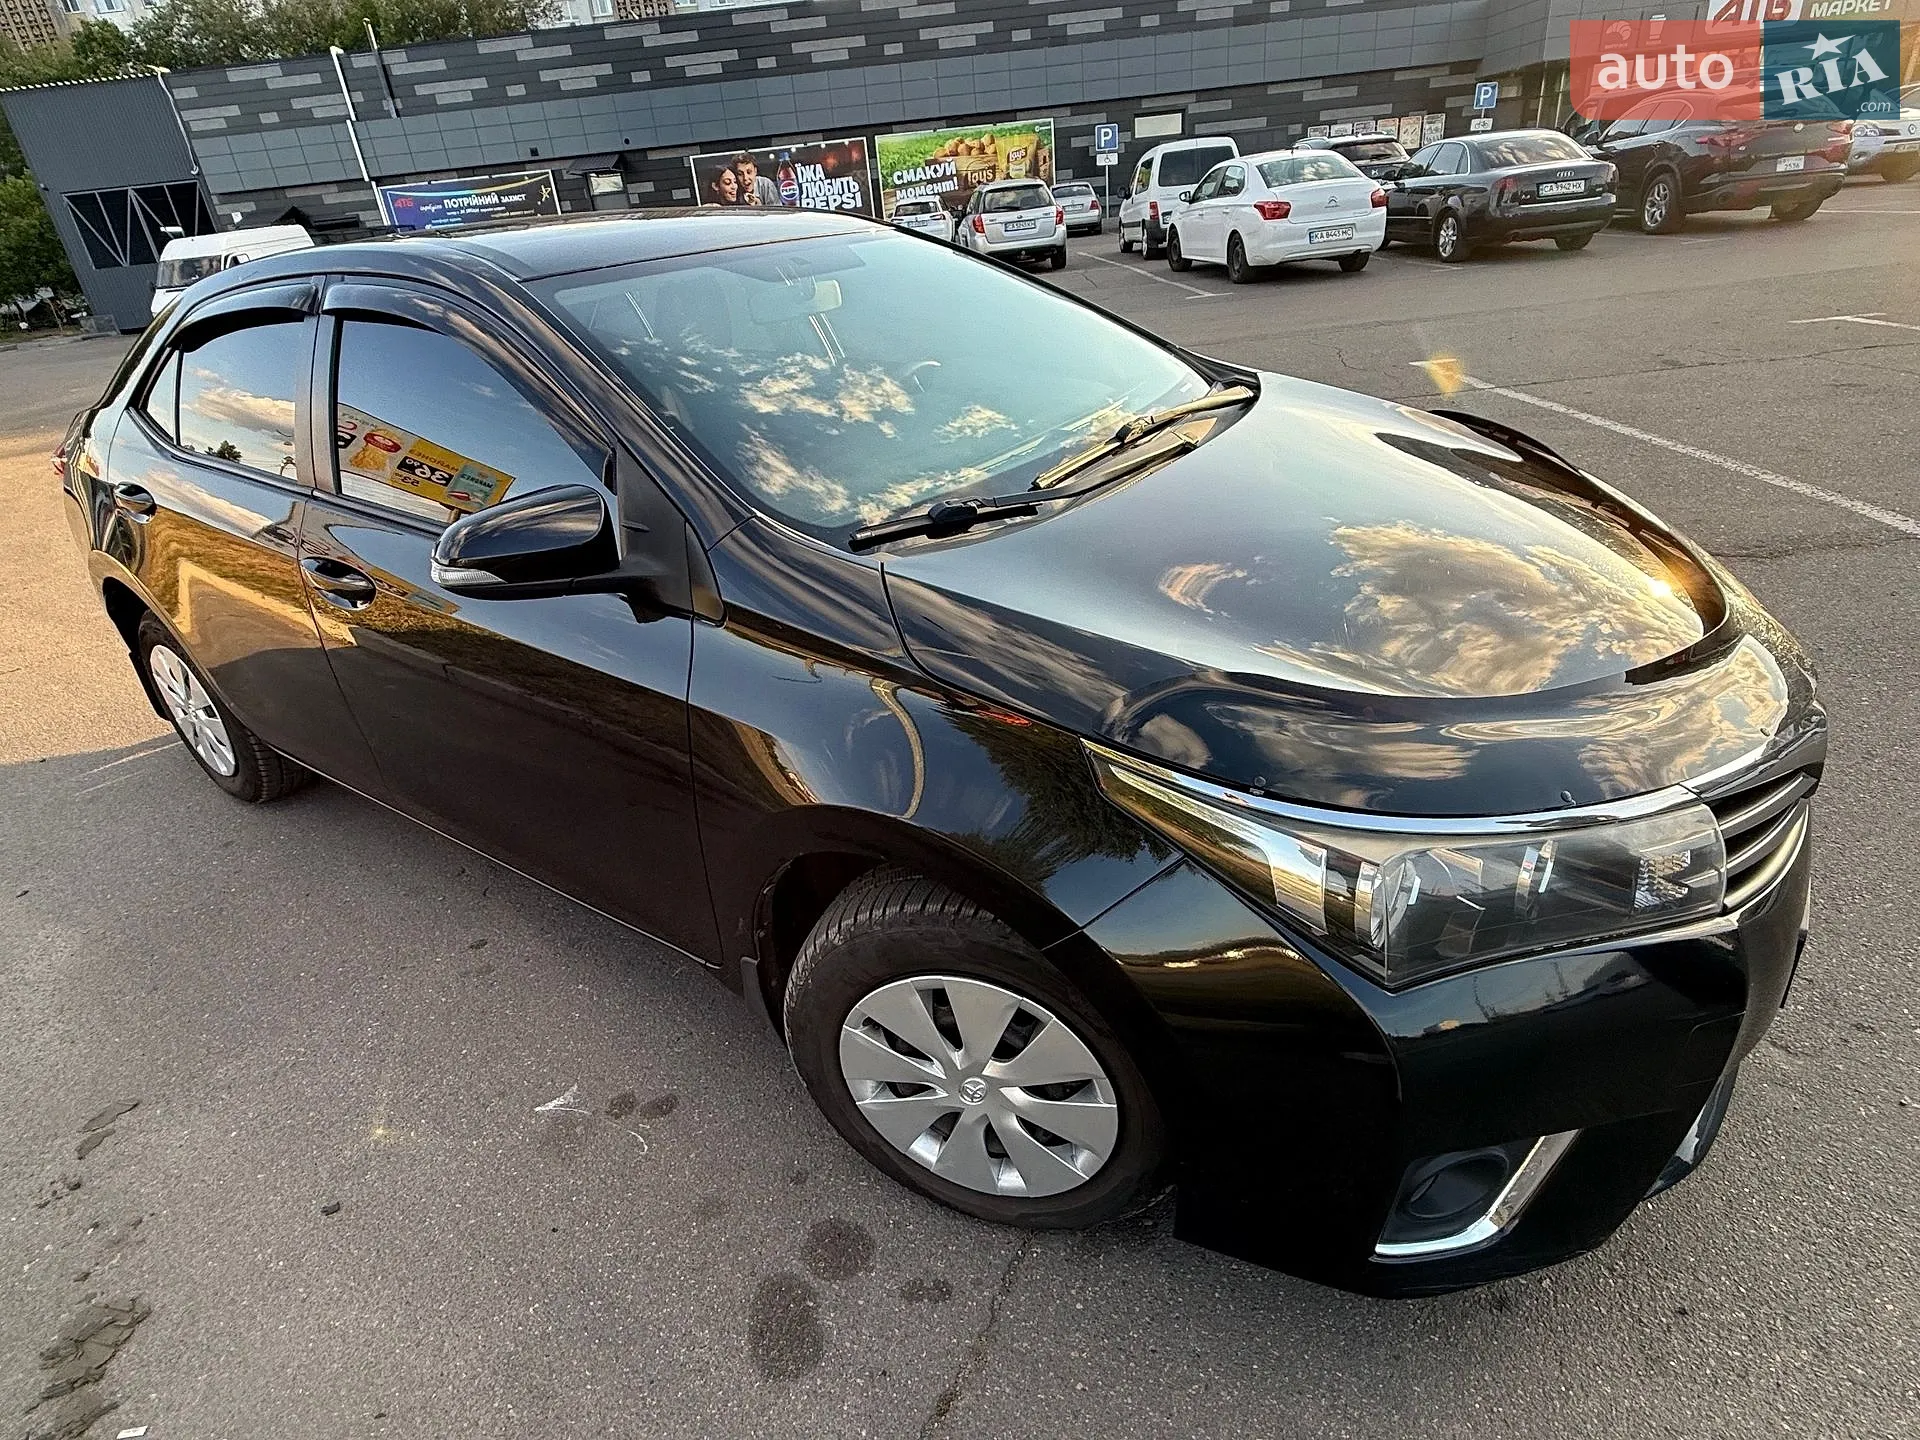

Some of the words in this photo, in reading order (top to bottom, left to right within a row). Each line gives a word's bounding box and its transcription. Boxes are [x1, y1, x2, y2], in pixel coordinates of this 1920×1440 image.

[1480, 87, 1492, 105] P
[1101, 128, 1113, 148] P
[795, 163, 825, 183] ЇЖА
[893, 159, 957, 184] СМАКУЙ
[801, 176, 860, 198] ЛЮБИТЬ
[444, 192, 499, 209] ПОТРІЙНИЙ
[801, 191, 863, 210] PEPSI
